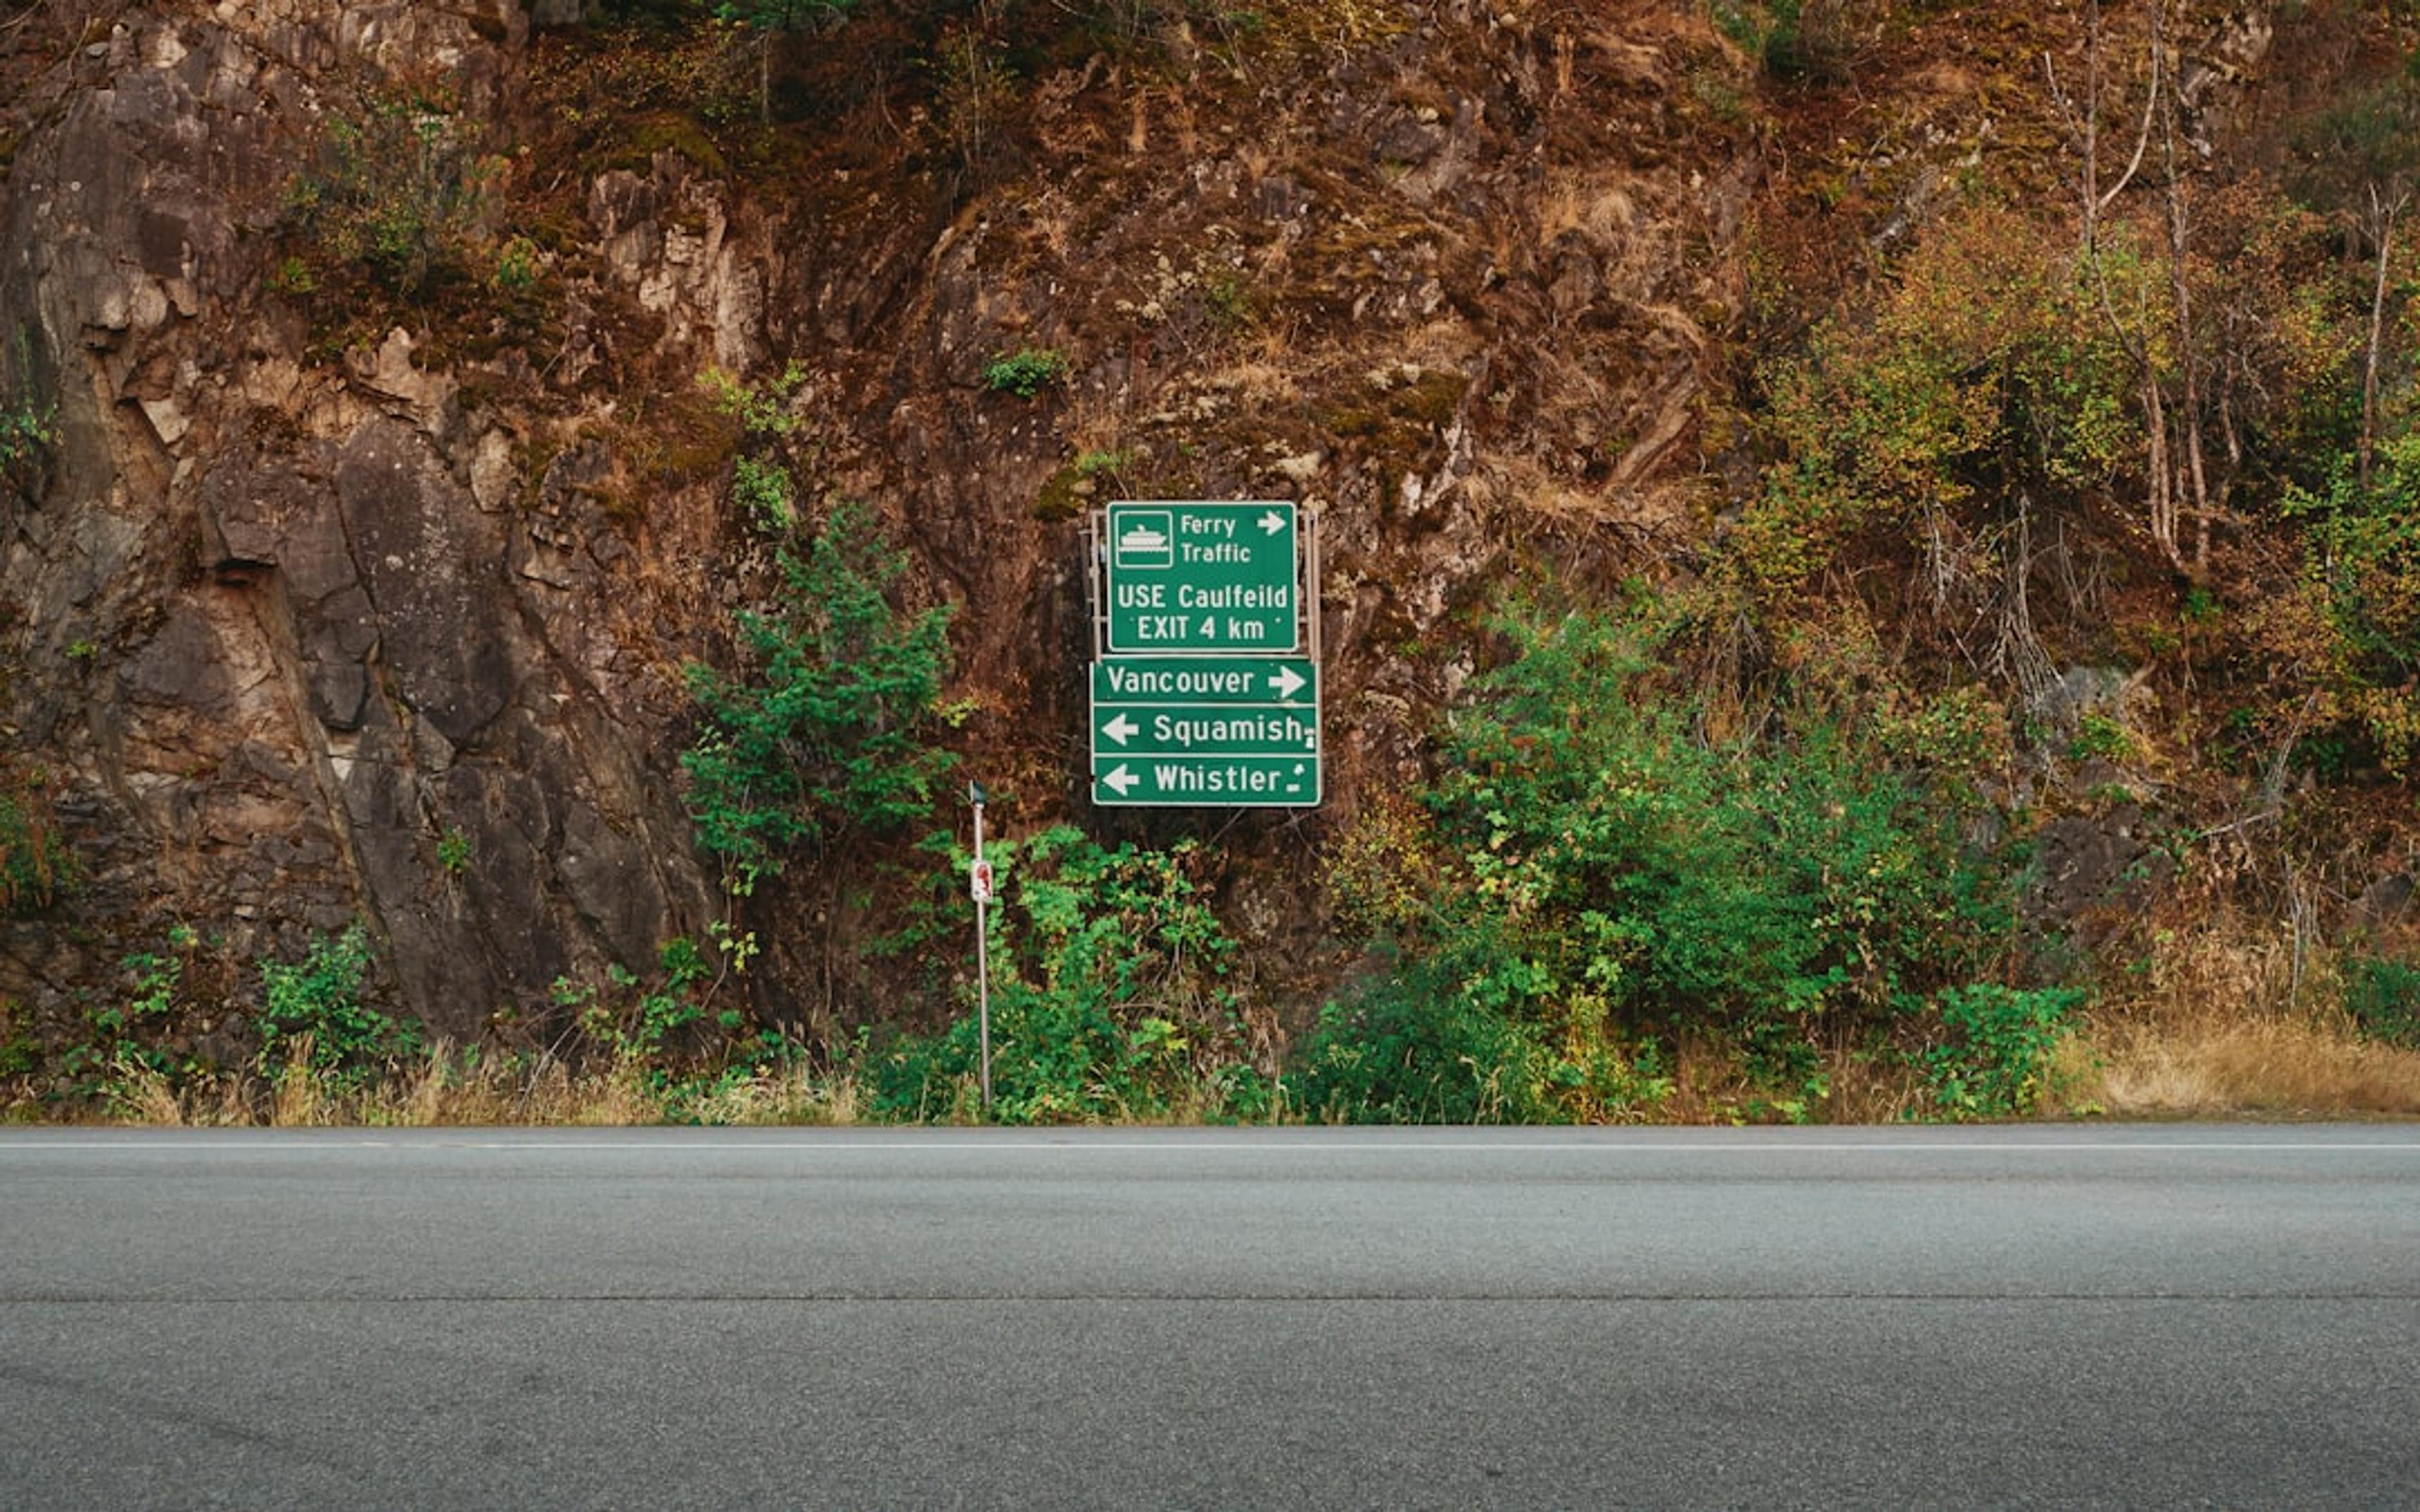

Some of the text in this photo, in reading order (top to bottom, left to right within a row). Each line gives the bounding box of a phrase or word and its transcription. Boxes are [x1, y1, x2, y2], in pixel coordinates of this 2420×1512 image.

[1181, 515, 1236, 538] Ferry
[1181, 542, 1250, 563] Traffic
[1118, 584, 1288, 608] USE Caulfeild
[1138, 616, 1264, 639] EXIT 4 km
[1107, 666, 1255, 693] Vancouver
[1154, 714, 1302, 747] Squamish
[1154, 765, 1281, 791] Whistler
